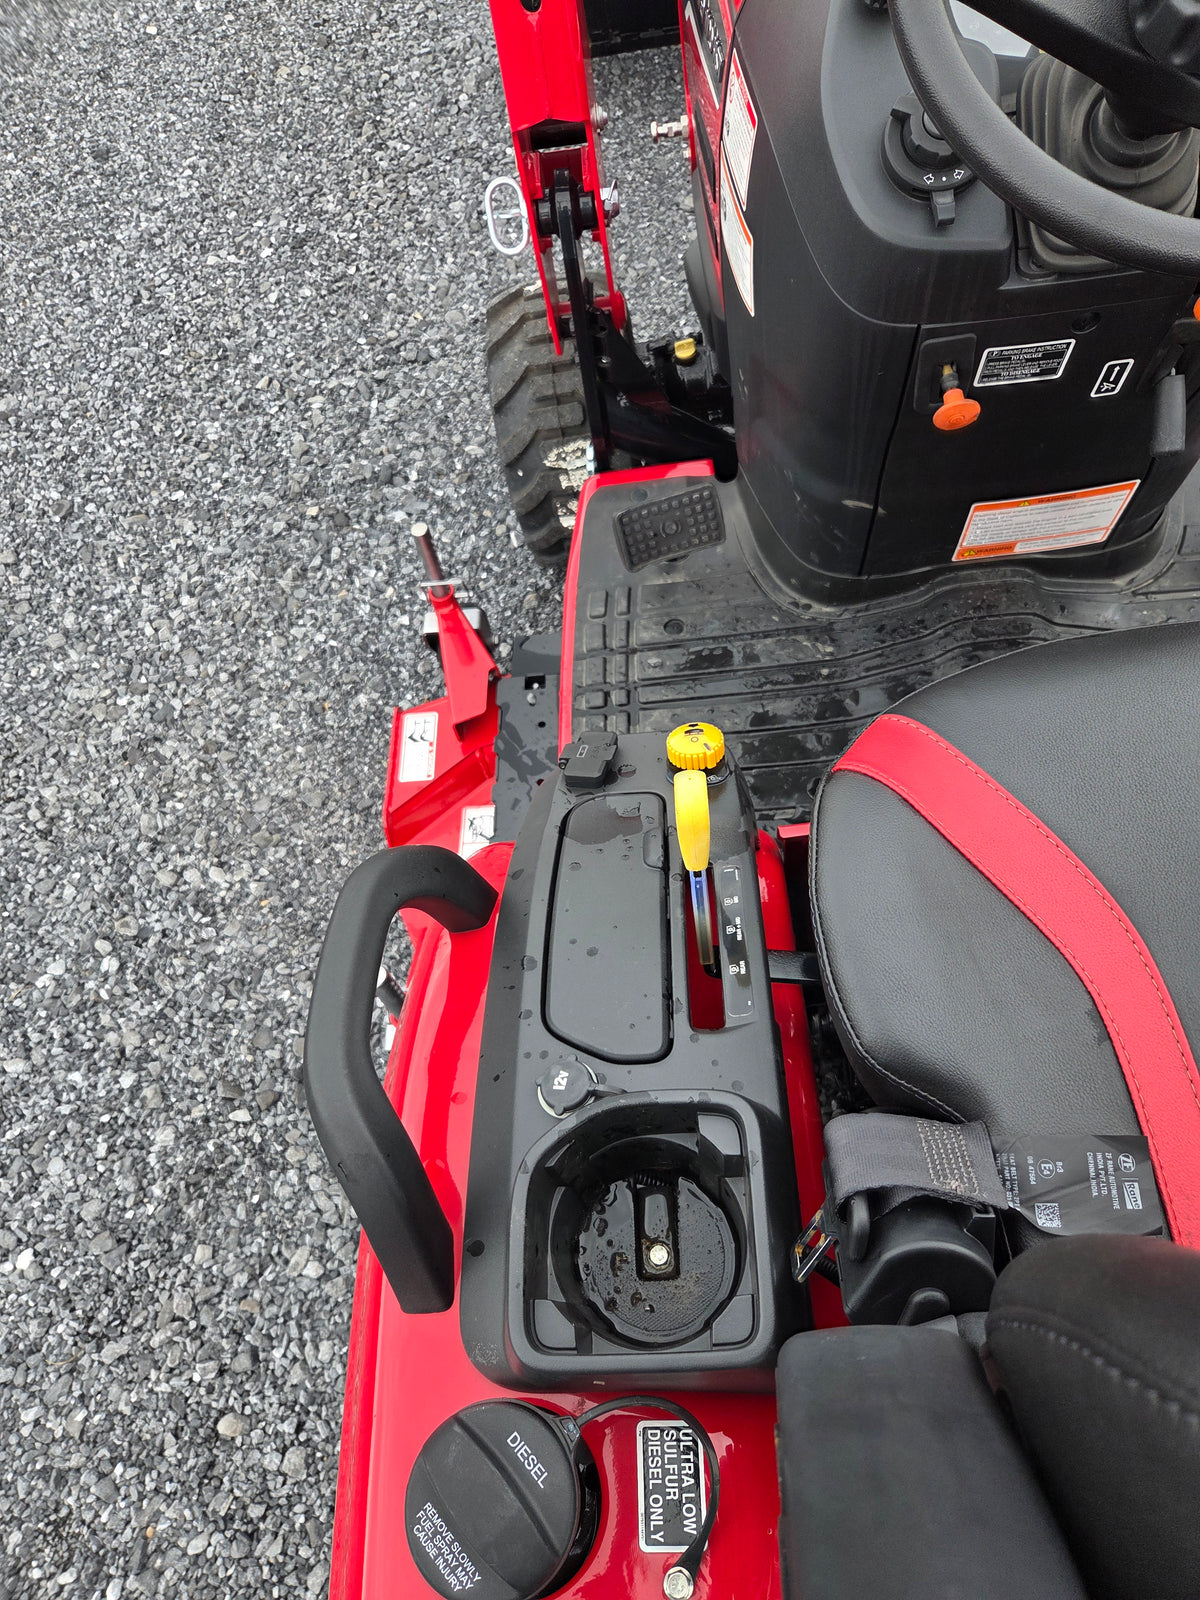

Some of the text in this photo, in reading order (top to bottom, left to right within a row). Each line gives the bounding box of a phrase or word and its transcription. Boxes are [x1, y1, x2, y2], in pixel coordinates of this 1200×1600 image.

[1009, 368, 1040, 376] DISENGAGE
[1037, 343, 1068, 352] INSTRUCTION
[1096, 1152, 1104, 1169] INDIA
[1107, 1160, 1115, 1175] RANE
[1119, 1154, 1141, 1209] ZF Rane
[1108, 1175, 1120, 1210] AUTOMOTIVE
[506, 1431, 548, 1489] DIESEL
[647, 1429, 665, 1543] DIESEL ONLY
[663, 1429, 679, 1501] SULFUR
[679, 1429, 697, 1535] ULTRA LOW
[413, 1524, 462, 1592] CAUSE INJURY
[416, 1510, 474, 1590] FUEL SPRAY MAY
[423, 1502, 482, 1582] REMOVE SLOWLY
